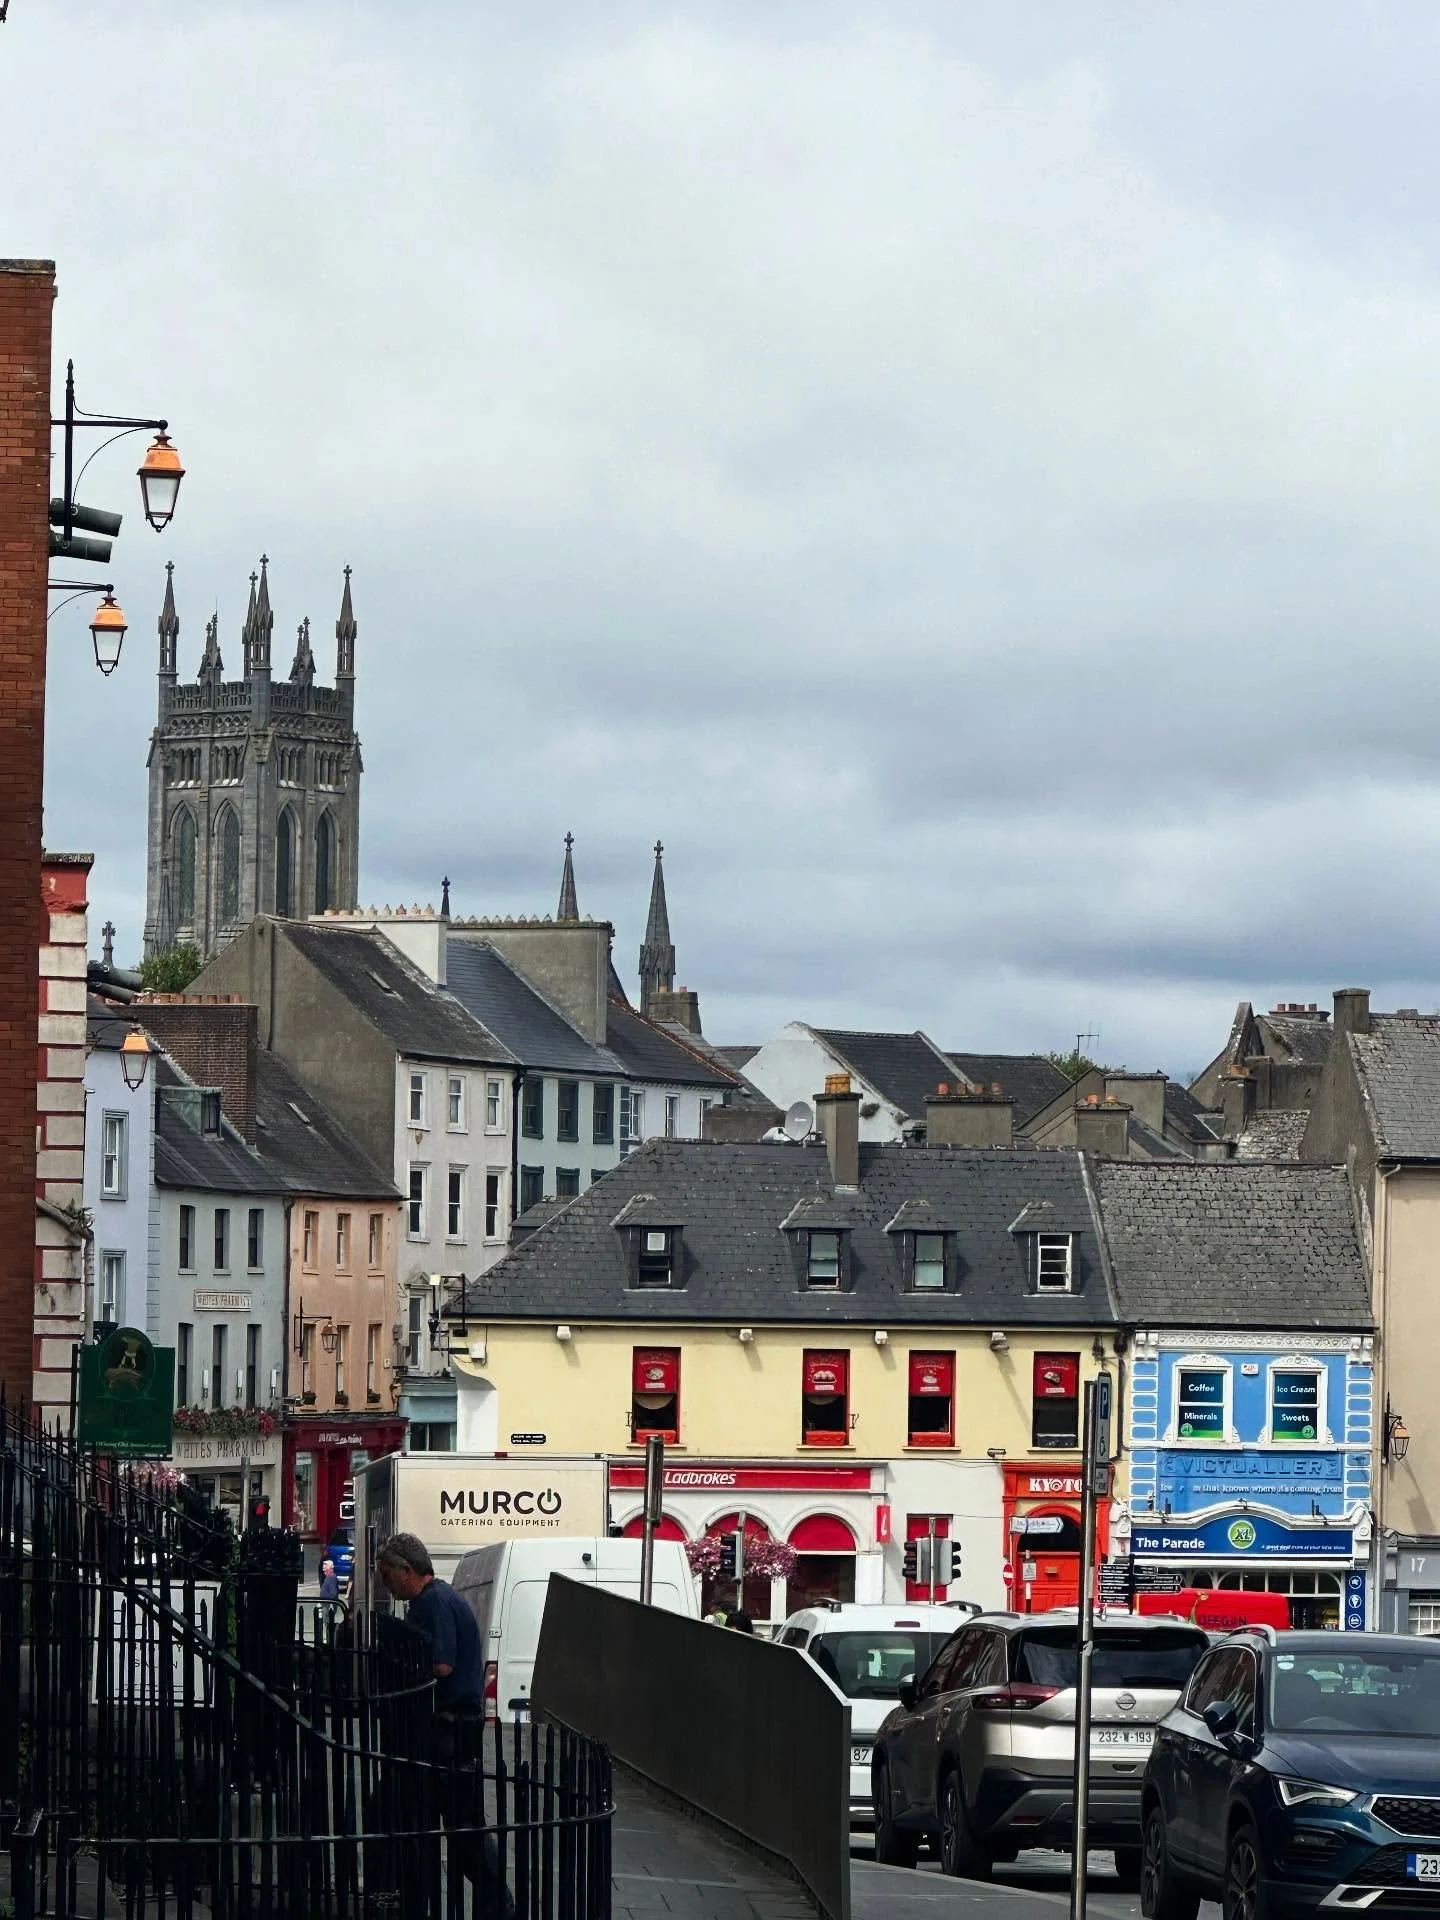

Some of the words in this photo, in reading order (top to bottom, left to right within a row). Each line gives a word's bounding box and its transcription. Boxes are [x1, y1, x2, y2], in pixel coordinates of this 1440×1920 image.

[1188, 1384, 1215, 1392] Coffee
[1277, 1385, 1288, 1393] Ice
[1184, 1412, 1217, 1420] Minerals
[1281, 1413, 1309, 1422] Sweets
[175, 1441, 212, 1459] WHITES
[216, 1439, 266, 1458] PHARMACY
[1181, 1458, 1323, 1475] VICTUALLER
[664, 1471, 737, 1485] Ladbrokes
[1203, 1484, 1220, 1492] that
[1223, 1484, 1250, 1493] knows
[440, 1488, 562, 1515] MURCO
[440, 1518, 493, 1526] CATERING
[500, 1519, 560, 1527] EQUIPMENT
[1136, 1537, 1159, 1548] The
[1162, 1537, 1205, 1549] Parade
[1412, 1557, 1426, 1572] 17
[1098, 1731, 1152, 1743] 232-W-193
[853, 1748, 870, 1761] 87
[1420, 1858, 1440, 1875] 23
